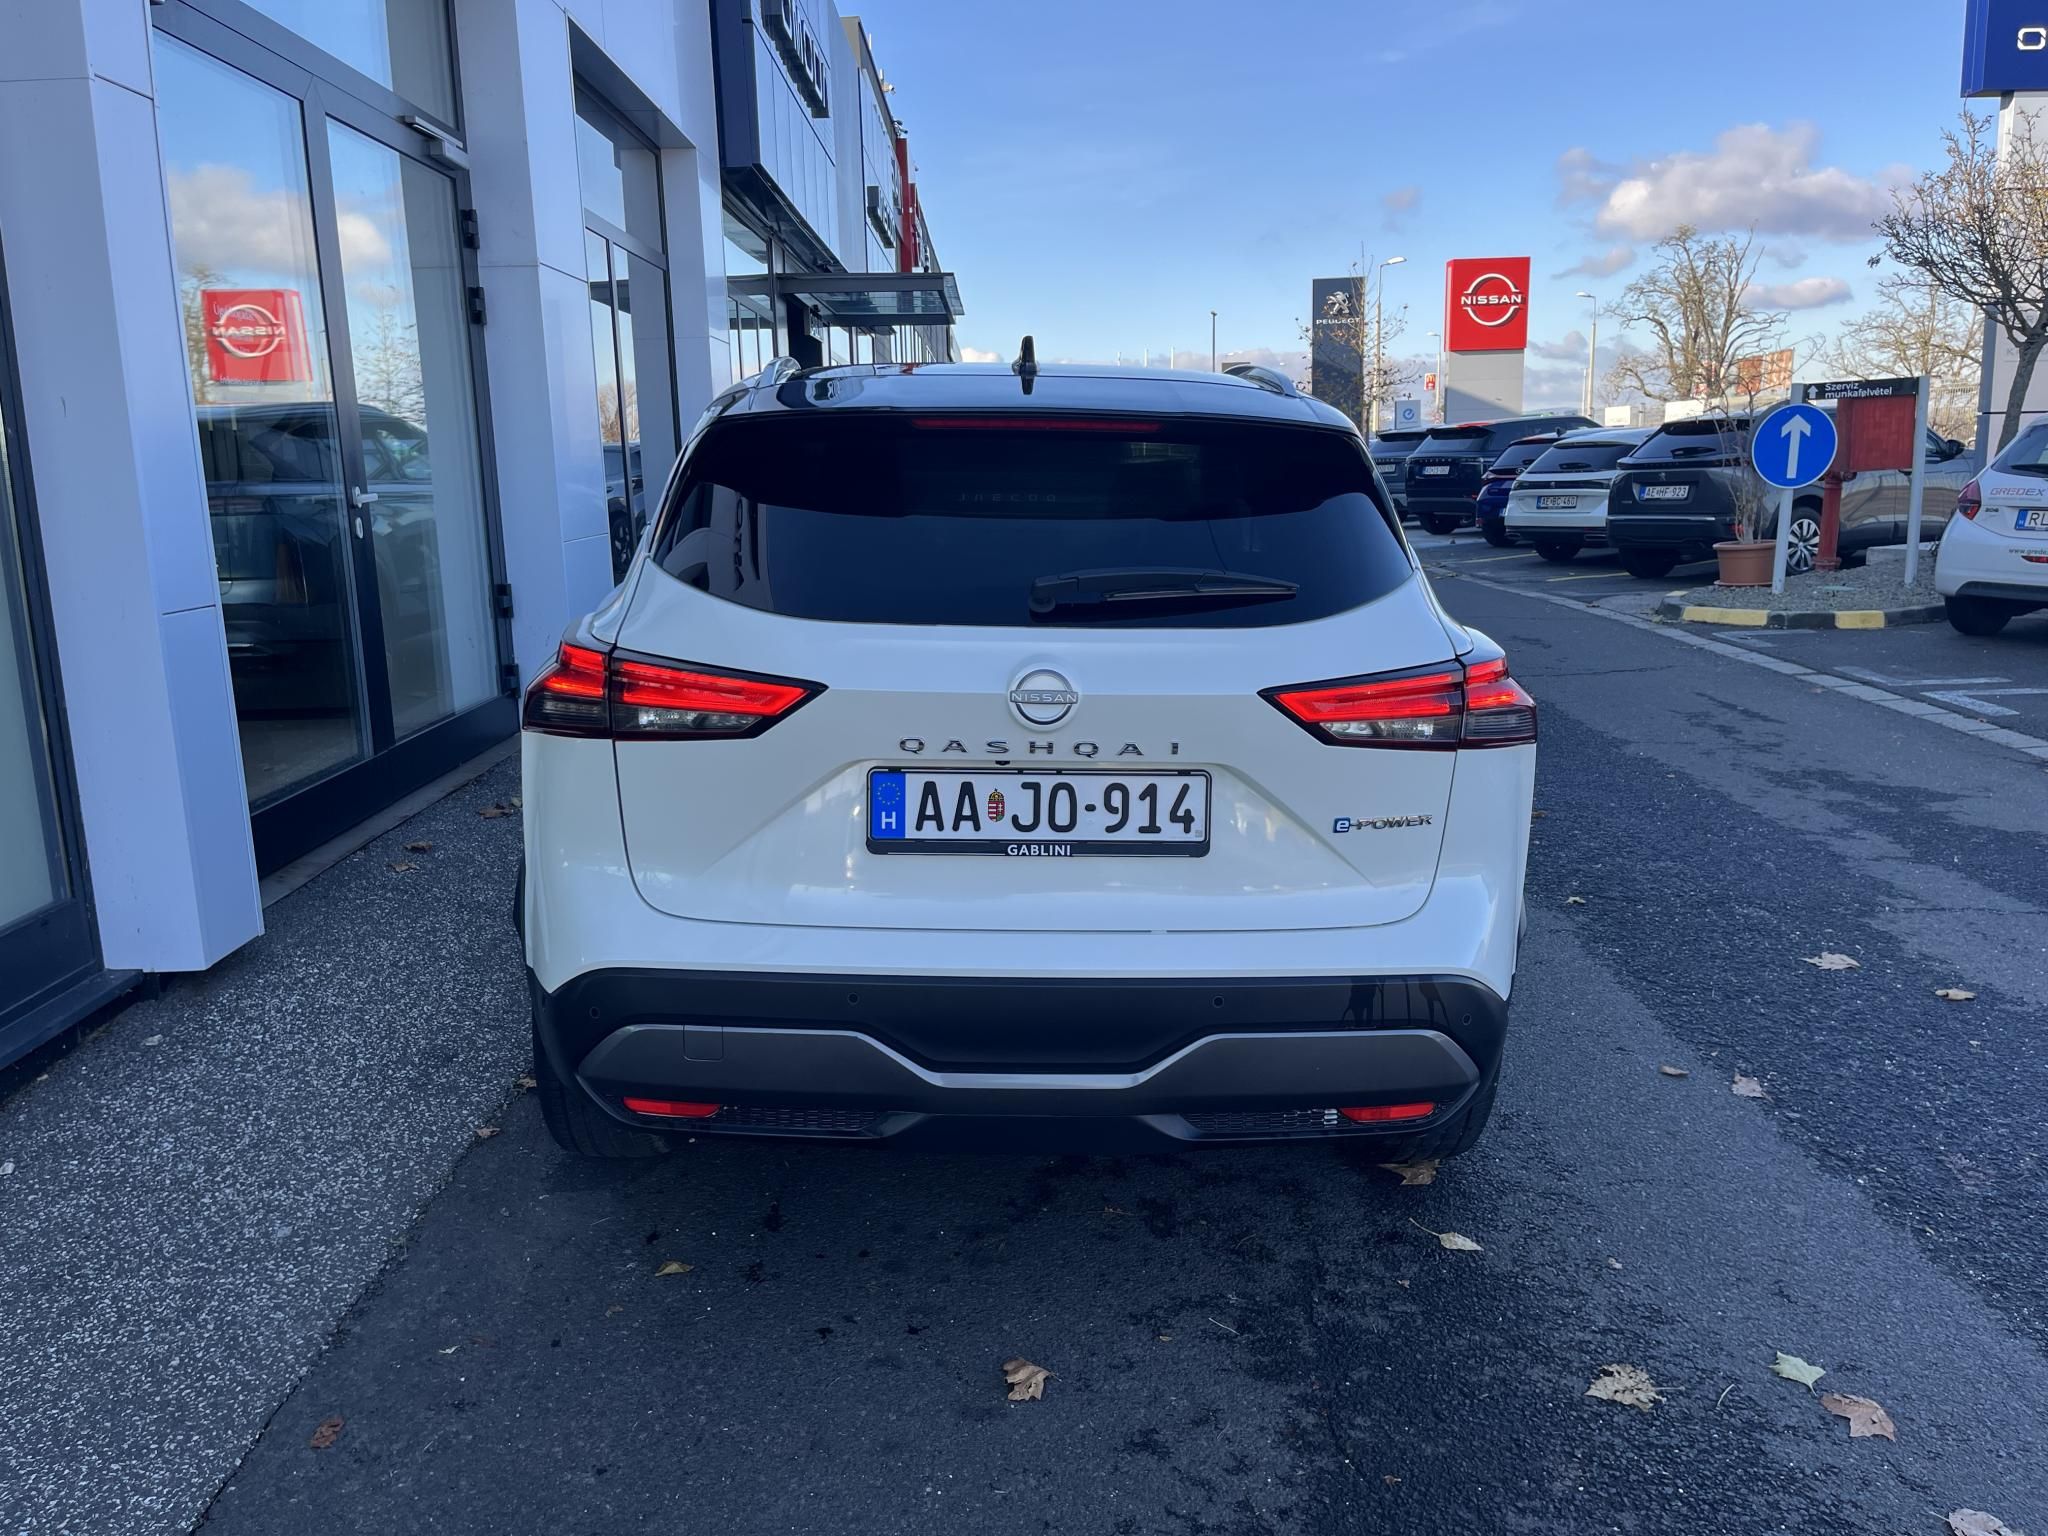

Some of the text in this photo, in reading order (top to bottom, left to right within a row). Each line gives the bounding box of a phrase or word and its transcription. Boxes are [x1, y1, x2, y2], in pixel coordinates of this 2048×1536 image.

[1461, 294, 1522, 305] NISSAN
[1825, 382, 1859, 391] Szerviz
[1990, 487, 2046, 496] GREDEX
[1010, 692, 1078, 704] NISSAN
[899, 738, 1180, 756] QASHQAI
[915, 780, 982, 833] AA
[1333, 813, 1433, 834] e-POWER
[1007, 844, 1072, 857] GABLINI
